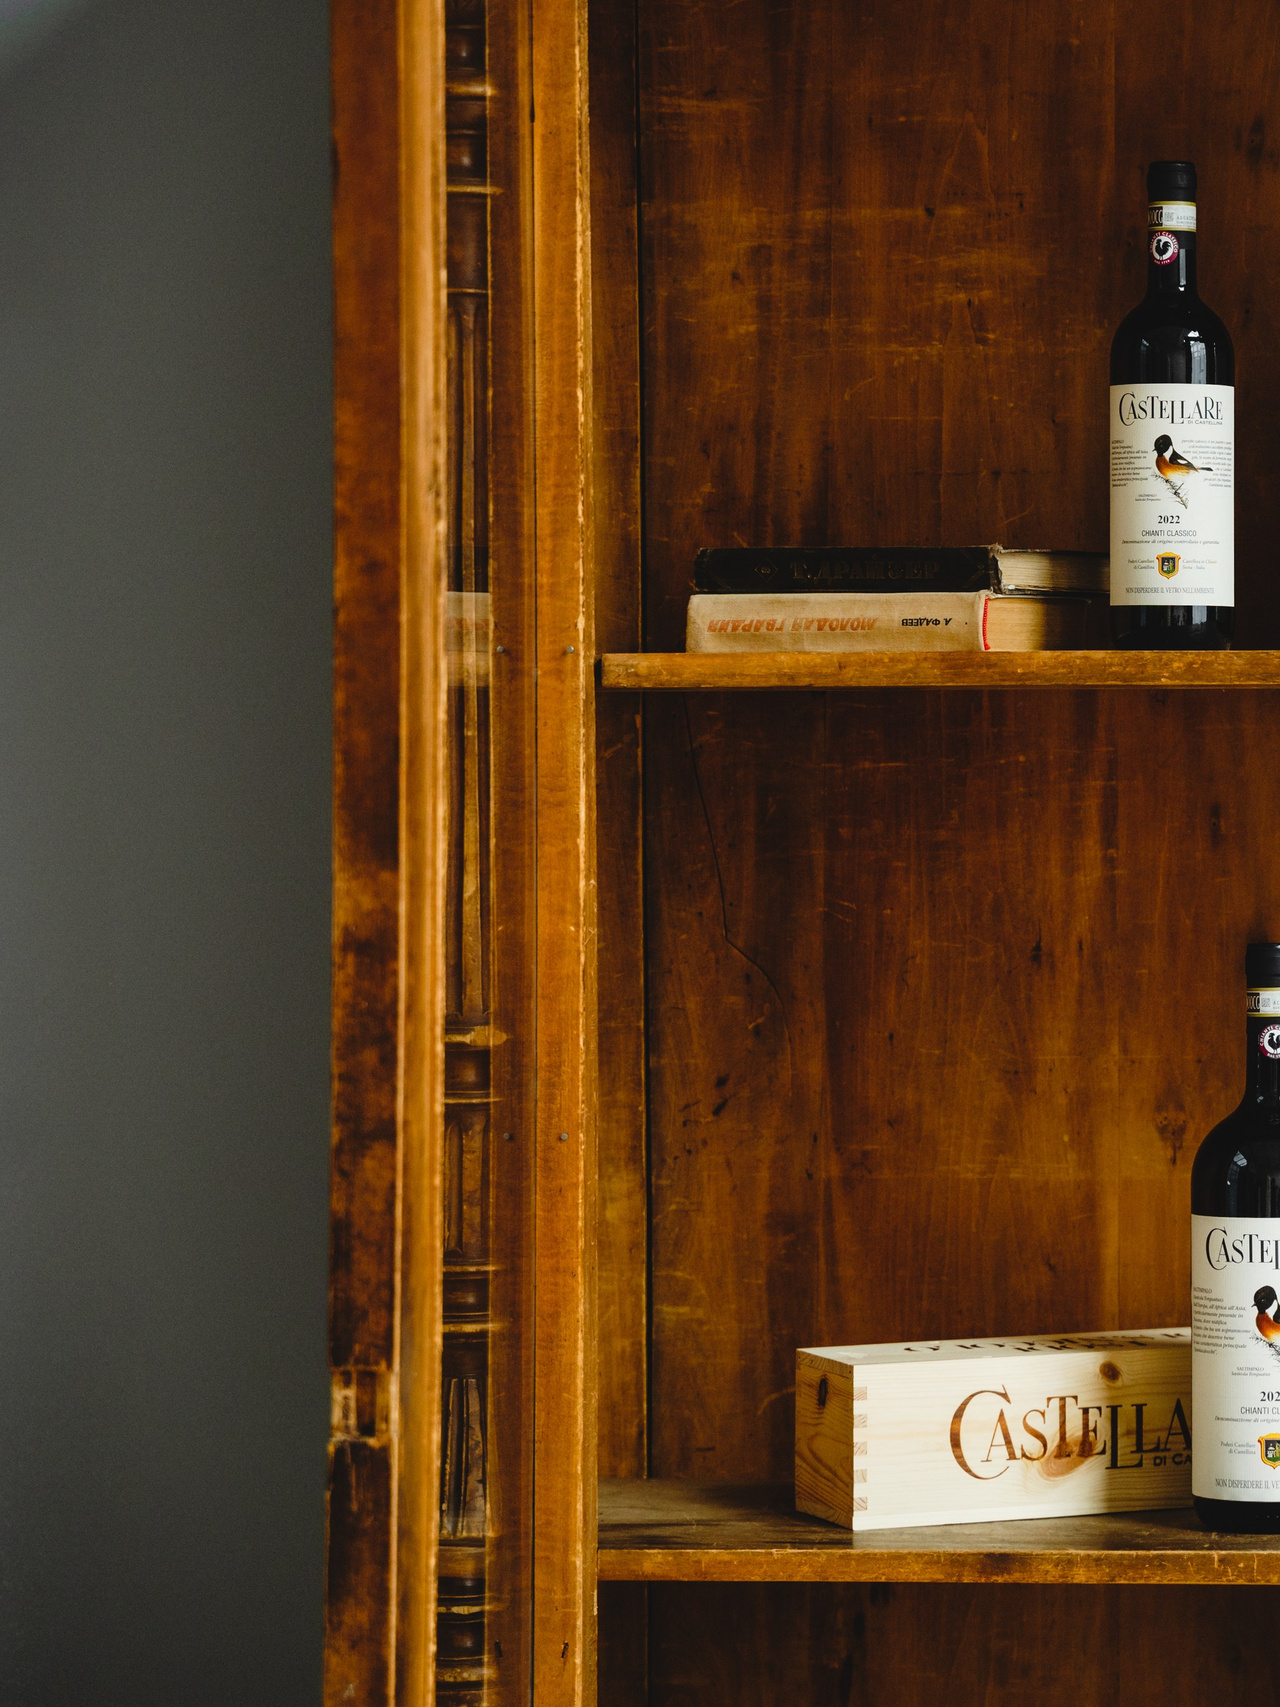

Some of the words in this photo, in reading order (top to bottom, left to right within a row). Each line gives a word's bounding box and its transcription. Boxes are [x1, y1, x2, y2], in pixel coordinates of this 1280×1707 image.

[1119, 391, 1223, 426] CASTELLARE
[1158, 515, 1180, 524] 2022
[814, 554, 940, 584] ДРАЙЗЕР
[706, 618, 785, 634] ГВАРДИЯ
[791, 617, 879, 633] МОЛОДАЯ
[901, 617, 941, 627] ФАДЕЕВ
[943, 617, 953, 627] А.
[1240, 1406, 1270, 1414] CHIANTI
[1153, 1455, 1167, 1467] DI
[1215, 1478, 1227, 1488] NON
[1228, 1479, 1263, 1489] DISPERDERE
[1265, 1480, 1271, 1489] IL
